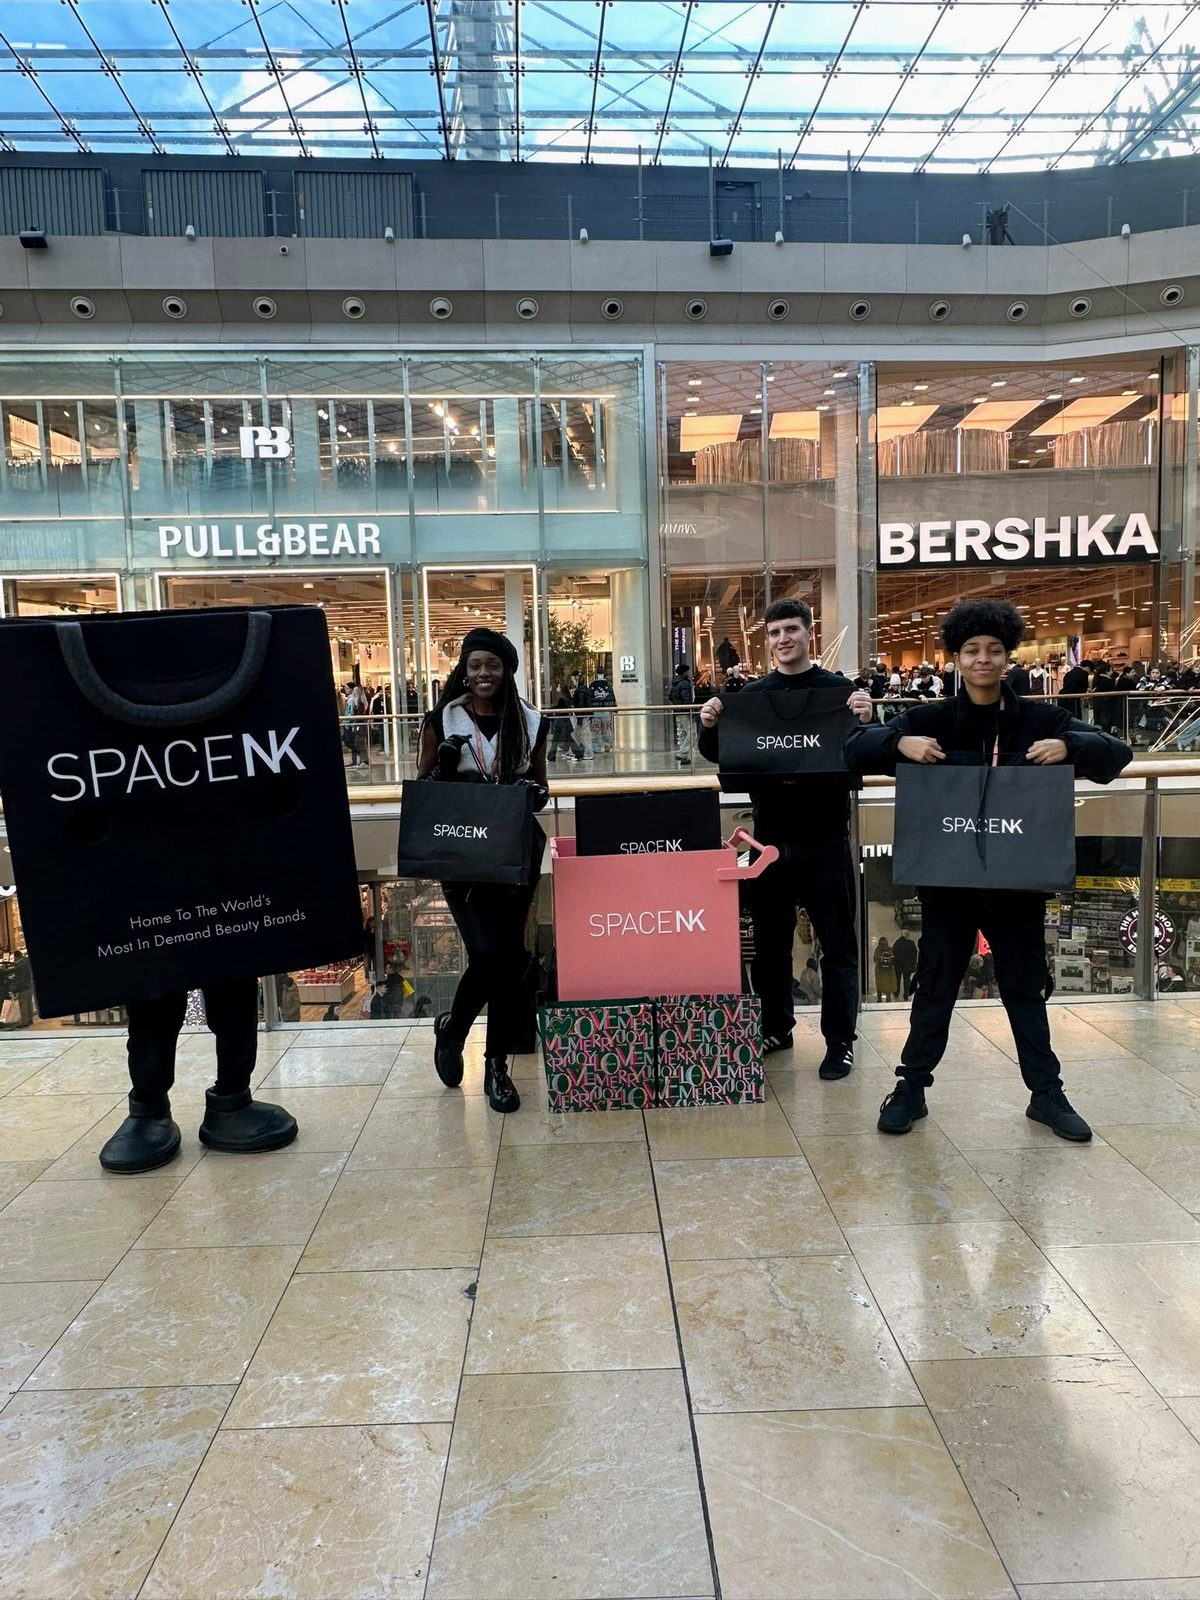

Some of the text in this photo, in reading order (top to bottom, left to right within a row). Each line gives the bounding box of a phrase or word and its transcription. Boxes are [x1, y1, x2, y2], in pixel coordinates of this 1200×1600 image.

[158, 523, 381, 558] PULL&BEAR
[879, 513, 1159, 564] BERSHKA
[130, 894, 272, 930] Home To The World's
[1120, 915, 1133, 931] THE
[97, 909, 307, 958] Most In Demand Beauty Brands
